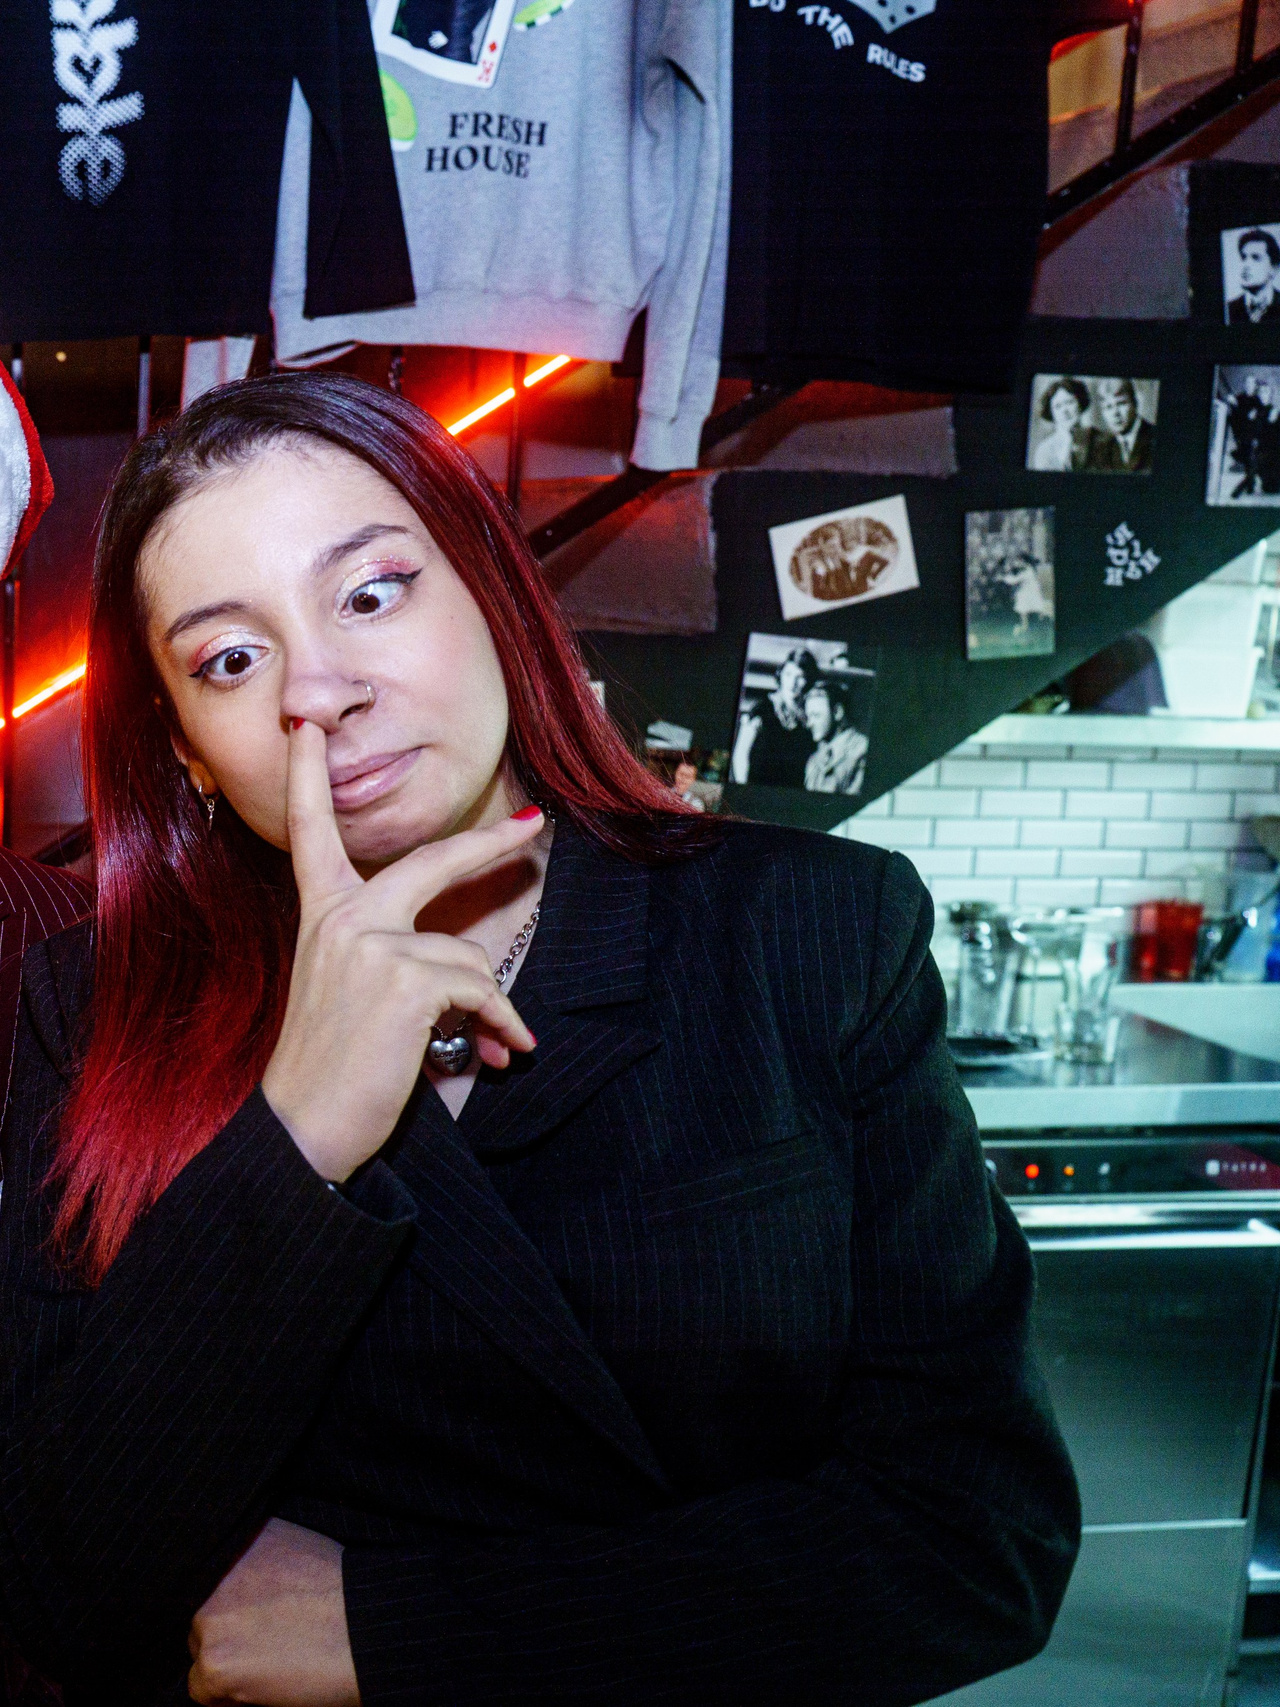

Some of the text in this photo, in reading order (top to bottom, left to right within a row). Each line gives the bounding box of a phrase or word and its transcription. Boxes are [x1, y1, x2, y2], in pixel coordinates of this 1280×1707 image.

[797, 5, 927, 83] THE RULES
[448, 111, 548, 147] FRESH
[424, 145, 531, 179] HOUSE
